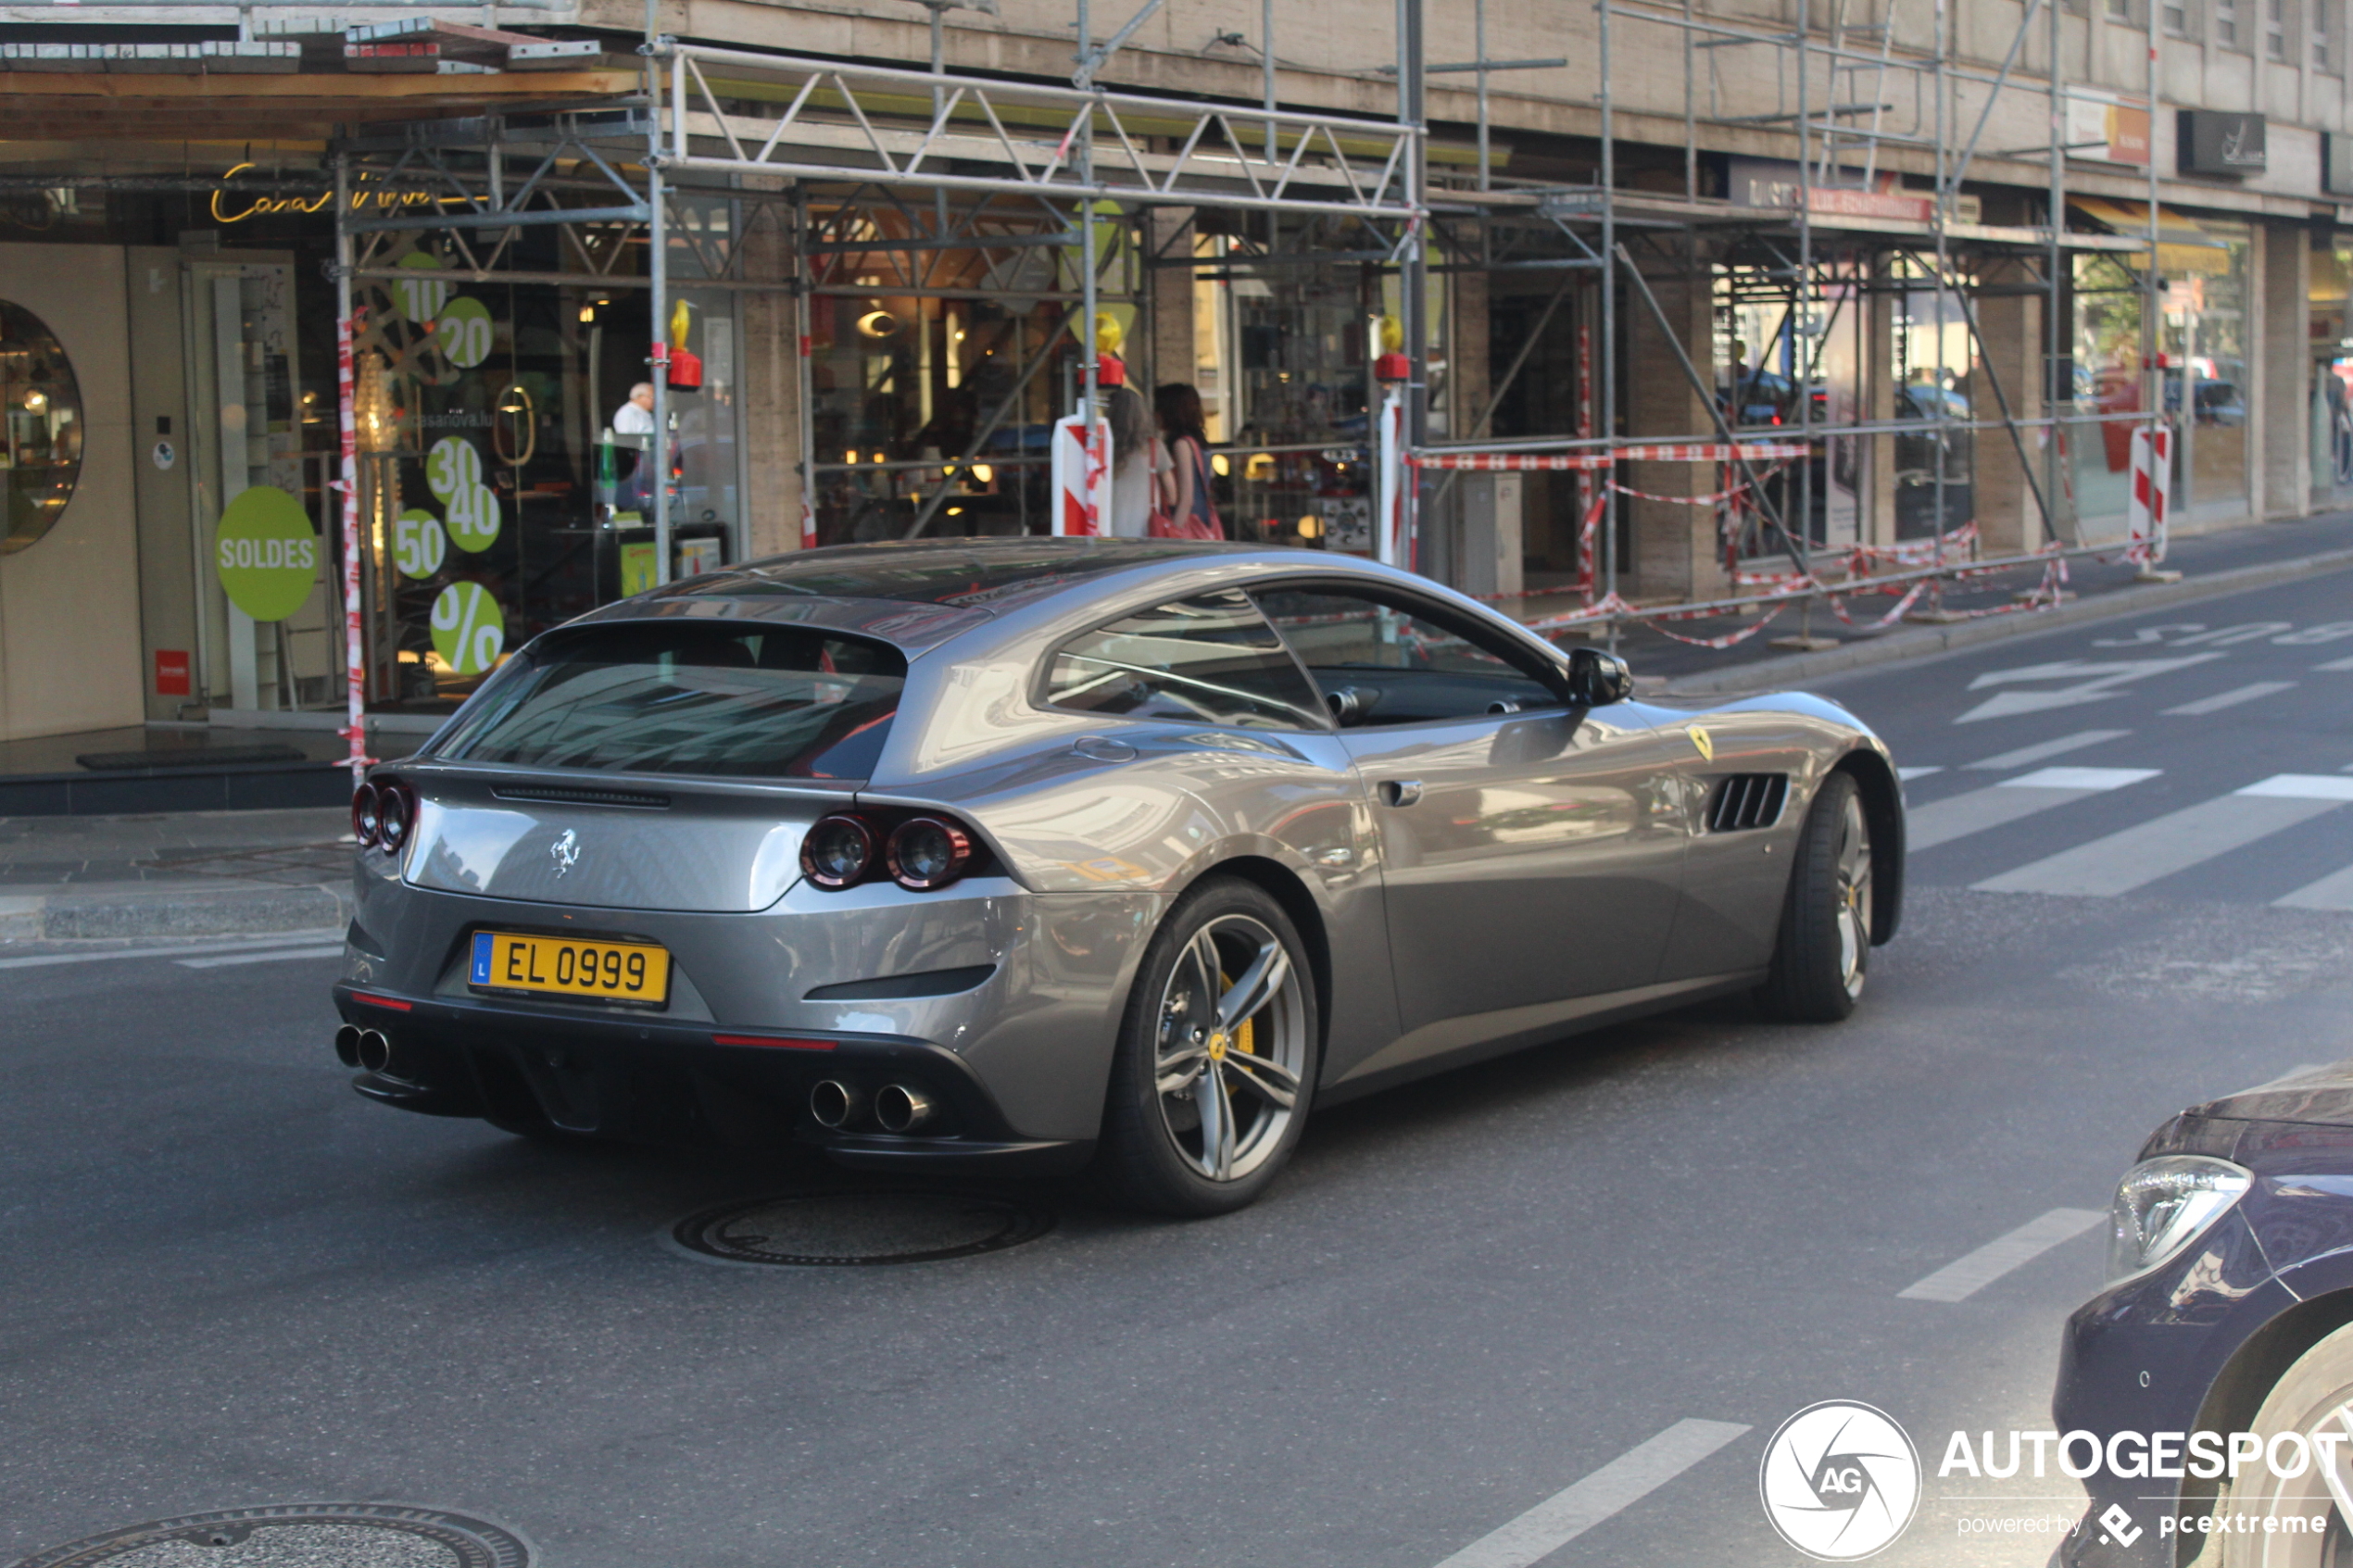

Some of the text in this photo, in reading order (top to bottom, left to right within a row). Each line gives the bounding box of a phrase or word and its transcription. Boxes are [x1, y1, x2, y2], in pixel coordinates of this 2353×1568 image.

[401, 279, 446, 323] 10
[440, 317, 491, 368] 20
[430, 439, 482, 494] 30
[448, 482, 500, 535] 40
[220, 538, 314, 570] SOLDES
[396, 520, 446, 574] 50
[430, 583, 504, 672] %
[478, 963, 485, 977] L
[507, 942, 646, 991] EL 0999
